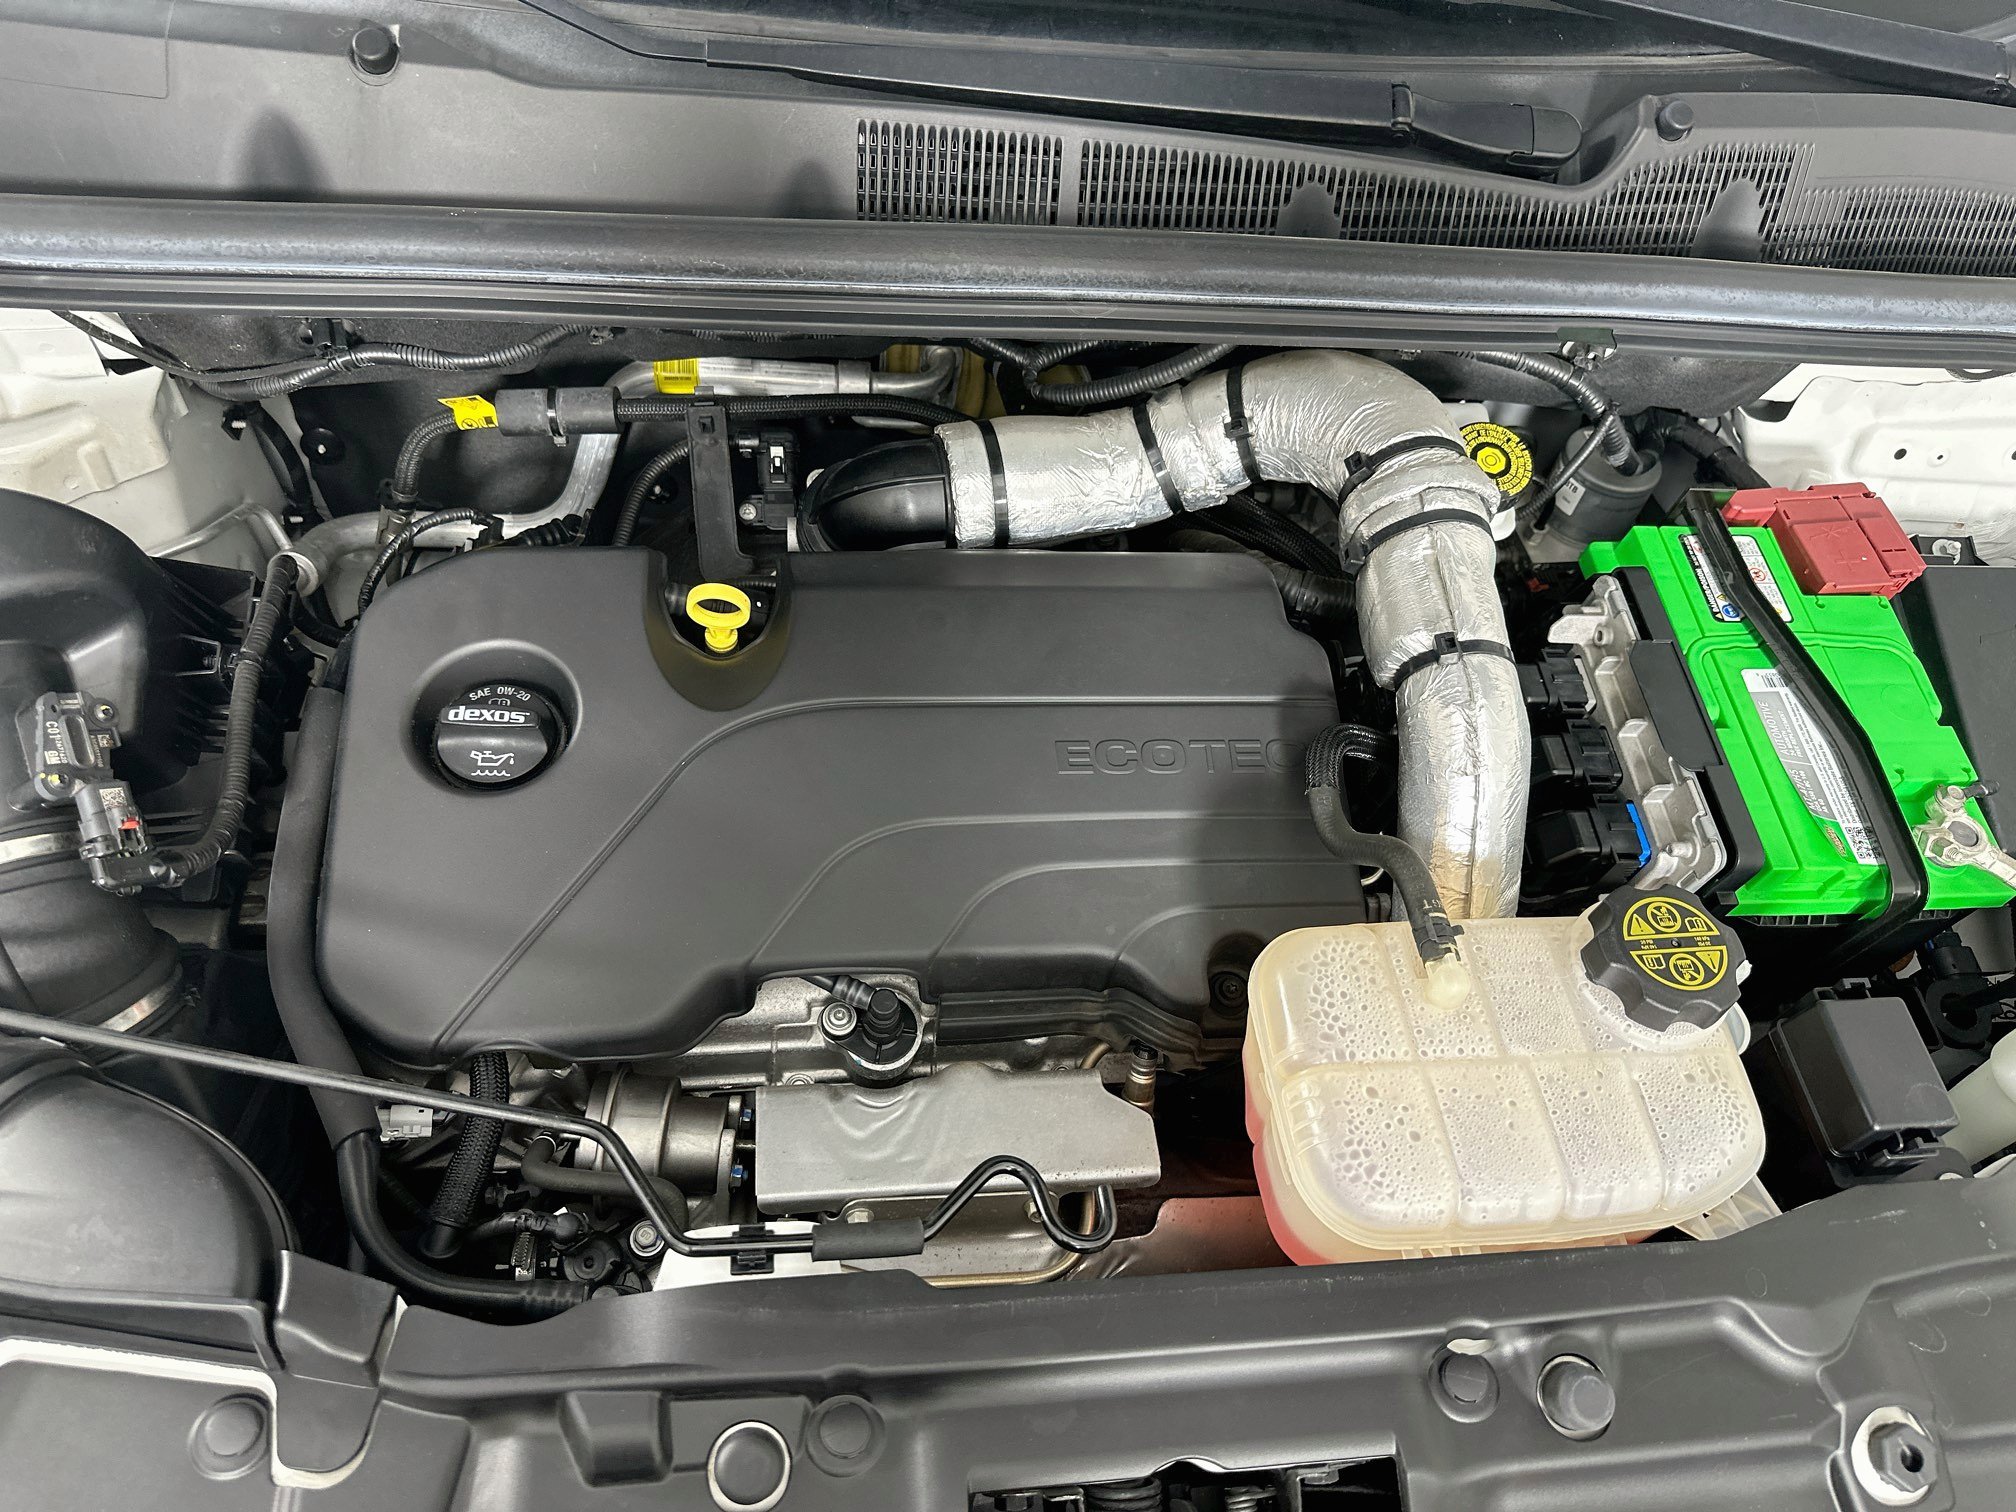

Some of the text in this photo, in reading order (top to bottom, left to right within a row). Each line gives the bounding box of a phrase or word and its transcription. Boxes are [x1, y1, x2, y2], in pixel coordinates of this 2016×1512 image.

[469, 686, 531, 702] SAE 0W-20
[448, 706, 526, 724] dexos
[45, 721, 62, 738] C01
[1757, 700, 1789, 755] AUTOMOTIVE
[46, 750, 62, 764] GM
[1054, 738, 1306, 775] ECOTEC
